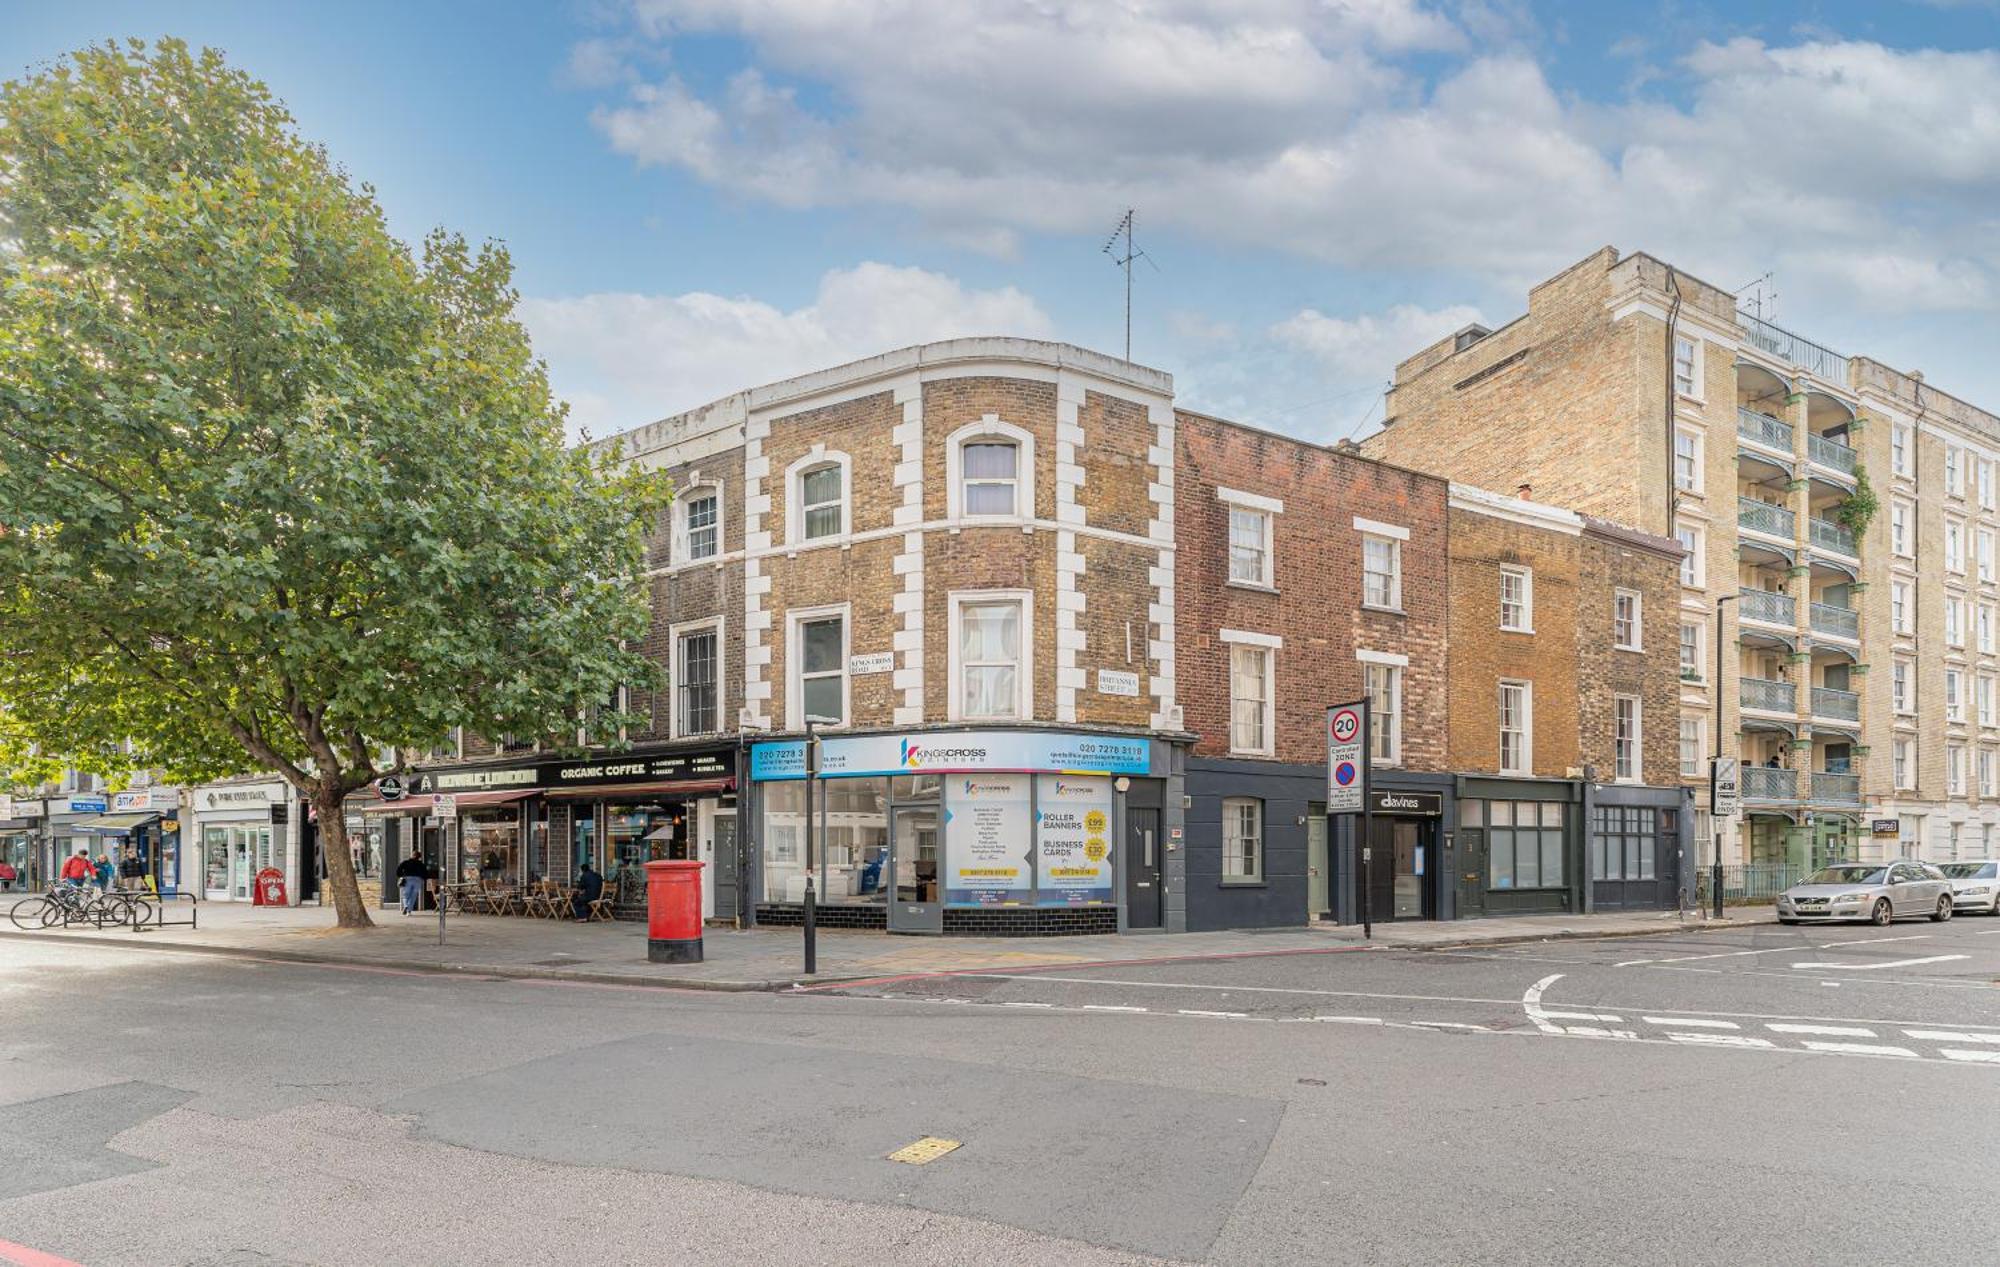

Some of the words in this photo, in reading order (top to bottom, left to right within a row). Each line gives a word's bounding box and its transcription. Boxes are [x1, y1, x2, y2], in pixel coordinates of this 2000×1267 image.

[1336, 718, 1355, 733] 20
[1079, 743, 1096, 752] 020
[1335, 753, 1355, 761] ZONE
[561, 766, 603, 779] ORGANIC
[605, 763, 646, 776] COFFEE
[1381, 791, 1419, 808] davines
[1043, 813, 1074, 821] ROLLER
[1043, 821, 1082, 830] BANNERS
[1043, 840, 1084, 849] BUSINESS
[1043, 848, 1072, 856] CARDS
